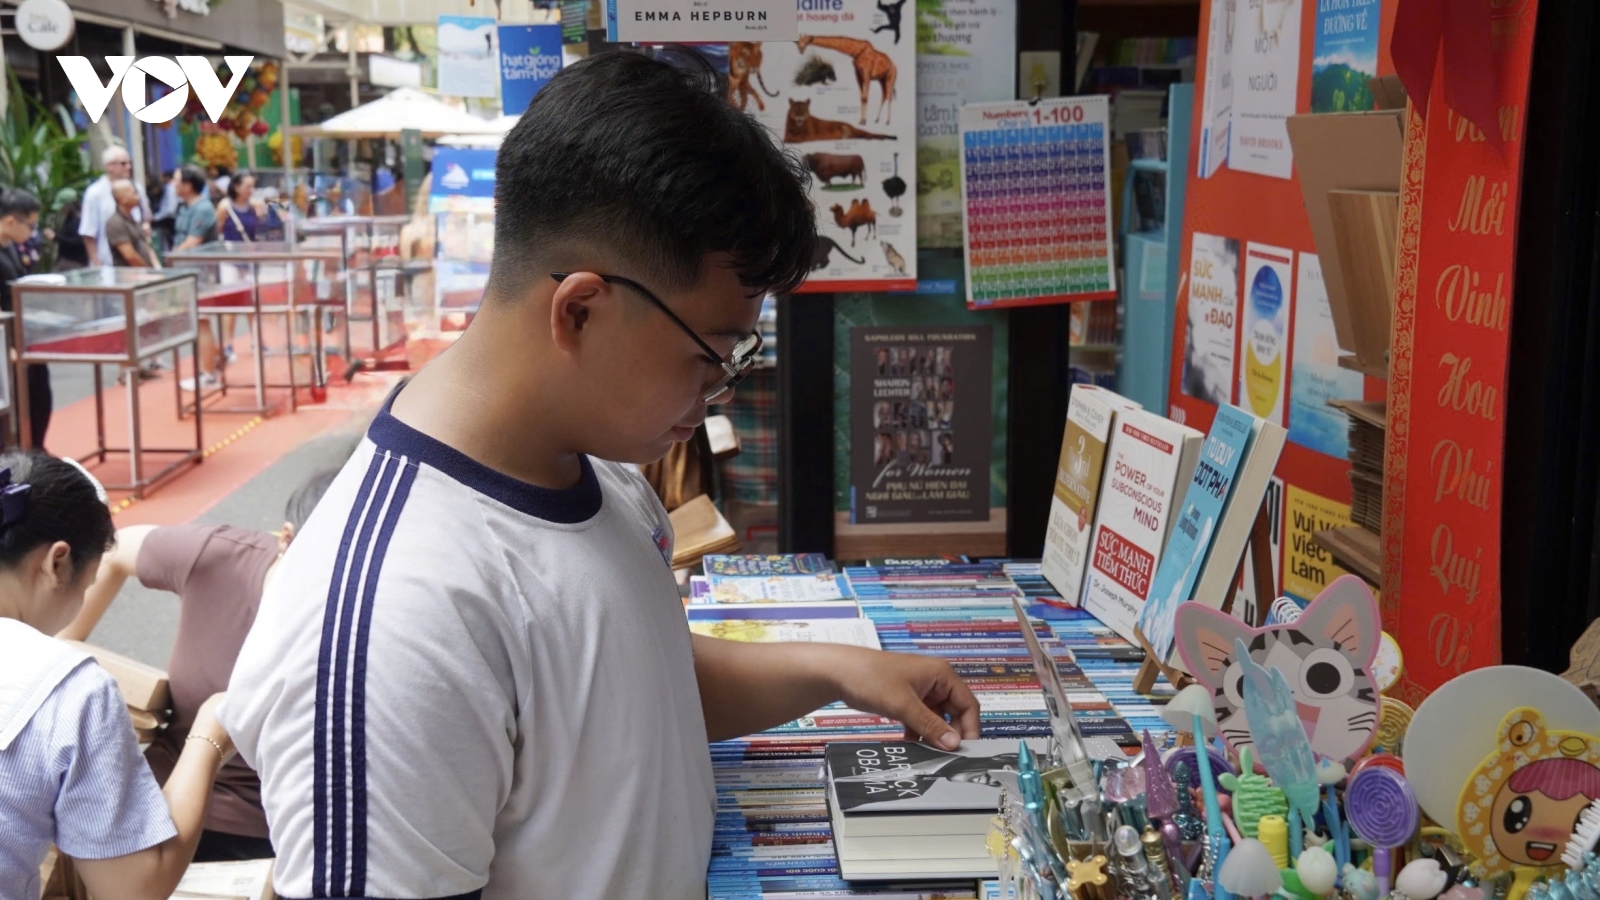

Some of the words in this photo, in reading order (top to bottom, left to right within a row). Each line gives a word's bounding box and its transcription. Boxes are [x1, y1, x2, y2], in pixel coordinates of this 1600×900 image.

[635, 11, 681, 21] EMMA
[690, 11, 768, 21] HEPBURN
[806, 13, 839, 24] hoang
[1032, 105, 1084, 125] 1-100
[1257, 137, 1283, 151] BROOKS
[1448, 174, 1508, 236] Mới
[1193, 257, 1213, 279] SỨC
[1435, 264, 1506, 332] Vinh
[1210, 308, 1233, 332] ĐẠO
[864, 334, 906, 342] NAPOLEON
[907, 334, 925, 342] HILL
[926, 332, 977, 341] FOUNDATION
[873, 379, 910, 388] SHARON
[873, 388, 910, 397] LECHTER
[1437, 352, 1498, 421] Hoa
[906, 461, 972, 477] Women
[1114, 459, 1147, 492] POWER
[1430, 438, 1494, 511] Phú
[1110, 477, 1163, 514] SUBCONSCIOUS
[1133, 505, 1159, 533] MIND
[1292, 509, 1315, 533] Vui
[1099, 528, 1119, 556] SỨC
[1117, 540, 1151, 577] MẠNH
[1429, 523, 1483, 605] Quý
[1120, 562, 1147, 596] THỨC
[1291, 555, 1326, 586] Làm
[1093, 578, 1101, 589] Dr.
[1100, 583, 1118, 602] Joseph
[1118, 594, 1138, 617] Murphy
[856, 748, 889, 795] OBAMA
[883, 746, 923, 797] BARCK
